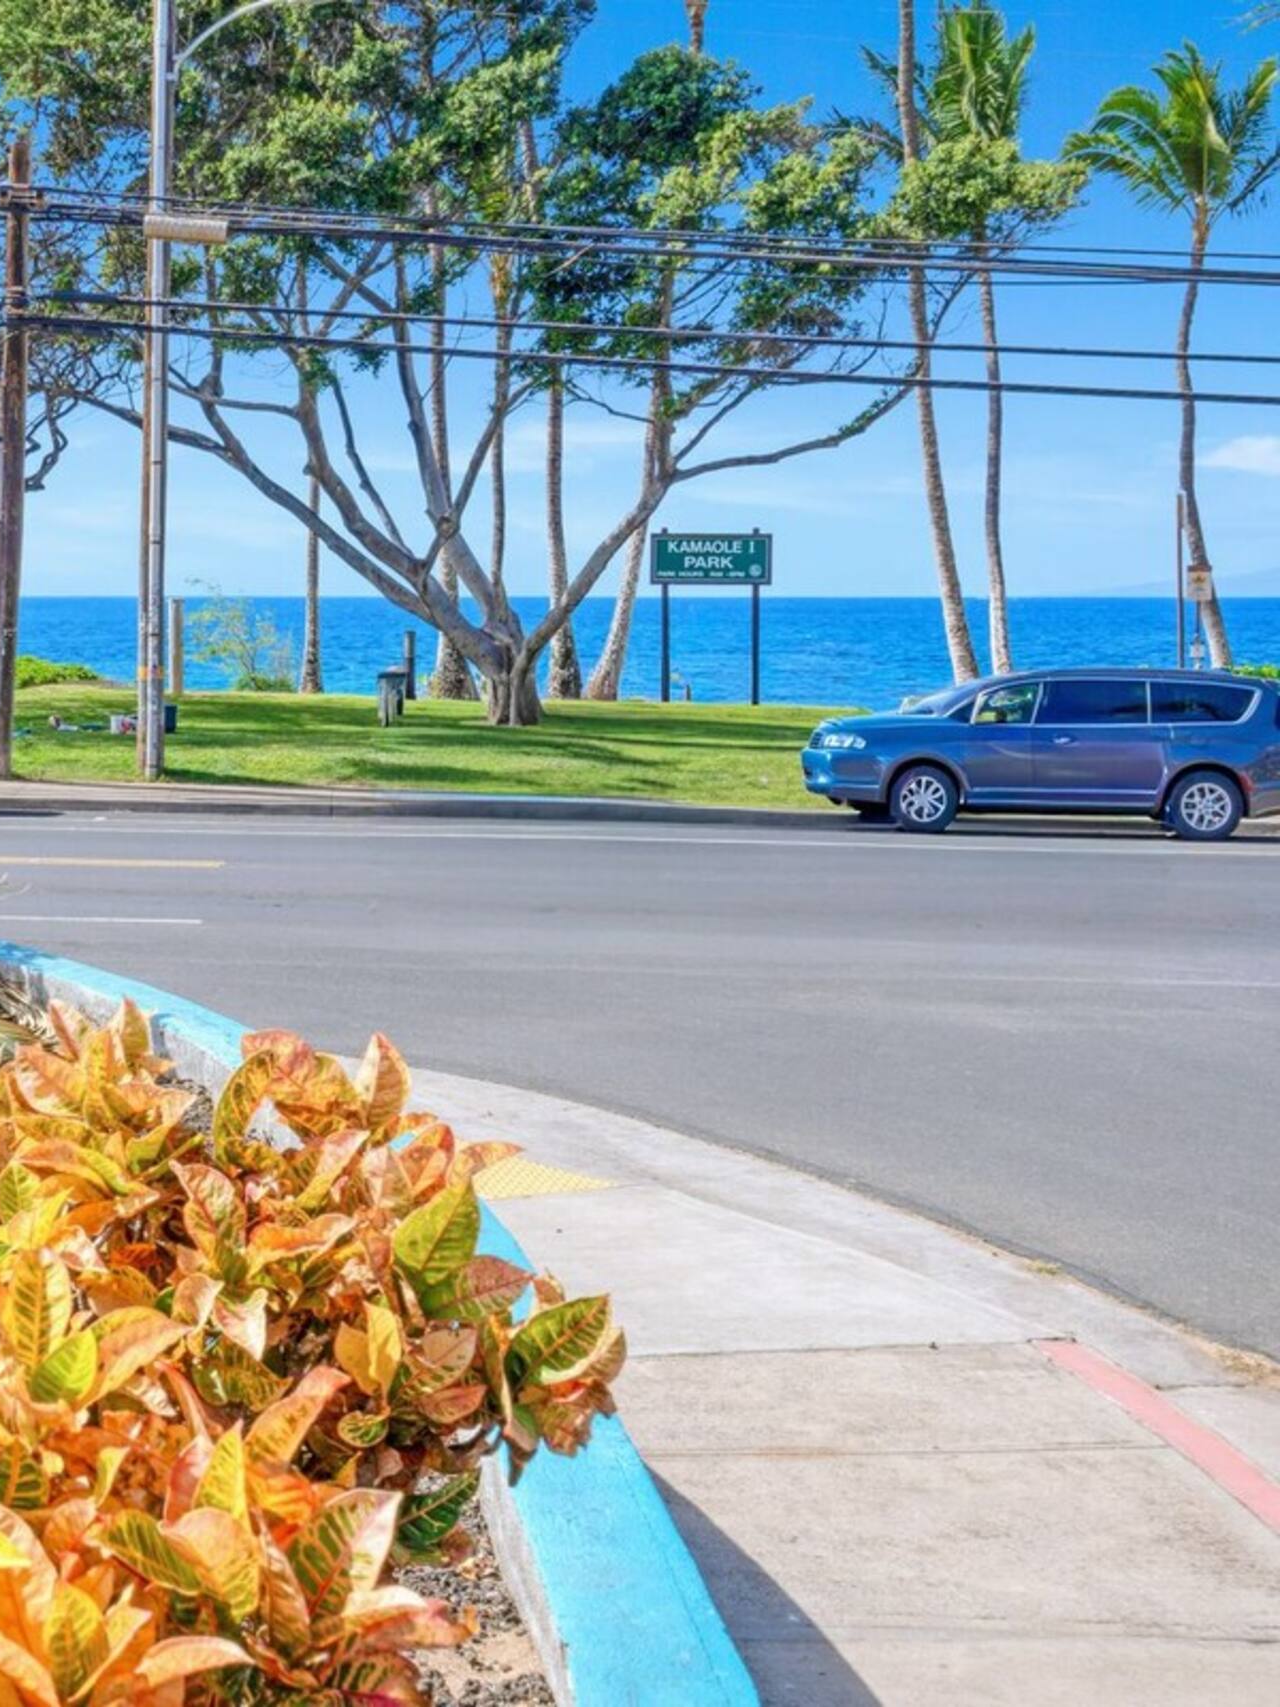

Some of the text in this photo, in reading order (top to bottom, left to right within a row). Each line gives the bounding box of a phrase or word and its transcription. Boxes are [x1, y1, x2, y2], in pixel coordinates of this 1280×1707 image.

[667, 541, 756, 554] KAMAOLE I
[684, 556, 733, 569] PARK
